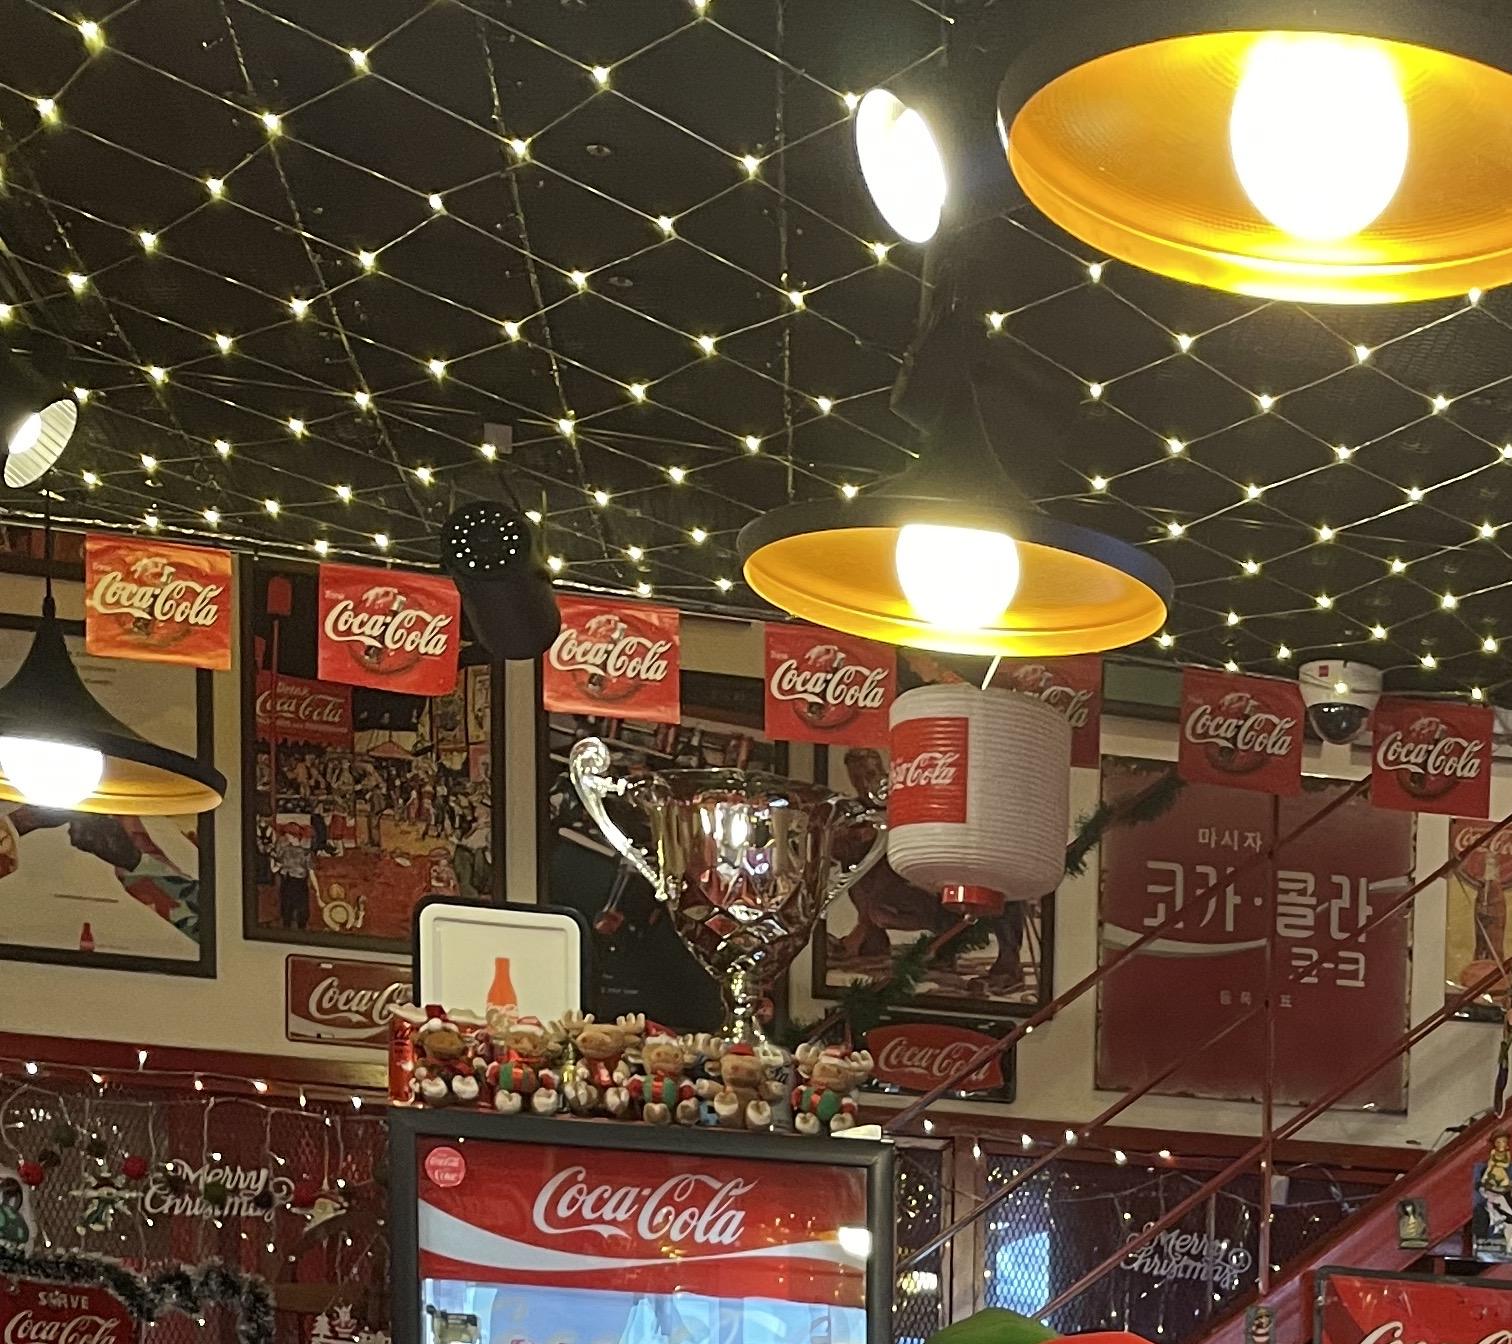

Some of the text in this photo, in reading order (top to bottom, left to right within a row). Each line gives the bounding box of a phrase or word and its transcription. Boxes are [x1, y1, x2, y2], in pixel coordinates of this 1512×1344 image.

[92, 571, 224, 627] Coca-Cola
[324, 600, 453, 656] Coca-Cola
[549, 627, 673, 682] Coca-Cola
[770, 660, 889, 709] Coca-Cola
[1185, 704, 1297, 757] Coca-Cola
[1376, 730, 1486, 779] Coca-Cola
[1198, 826, 1264, 853] 마시자
[308, 978, 412, 1020] Coca-C
[532, 1165, 759, 1246] Coca-Cola
